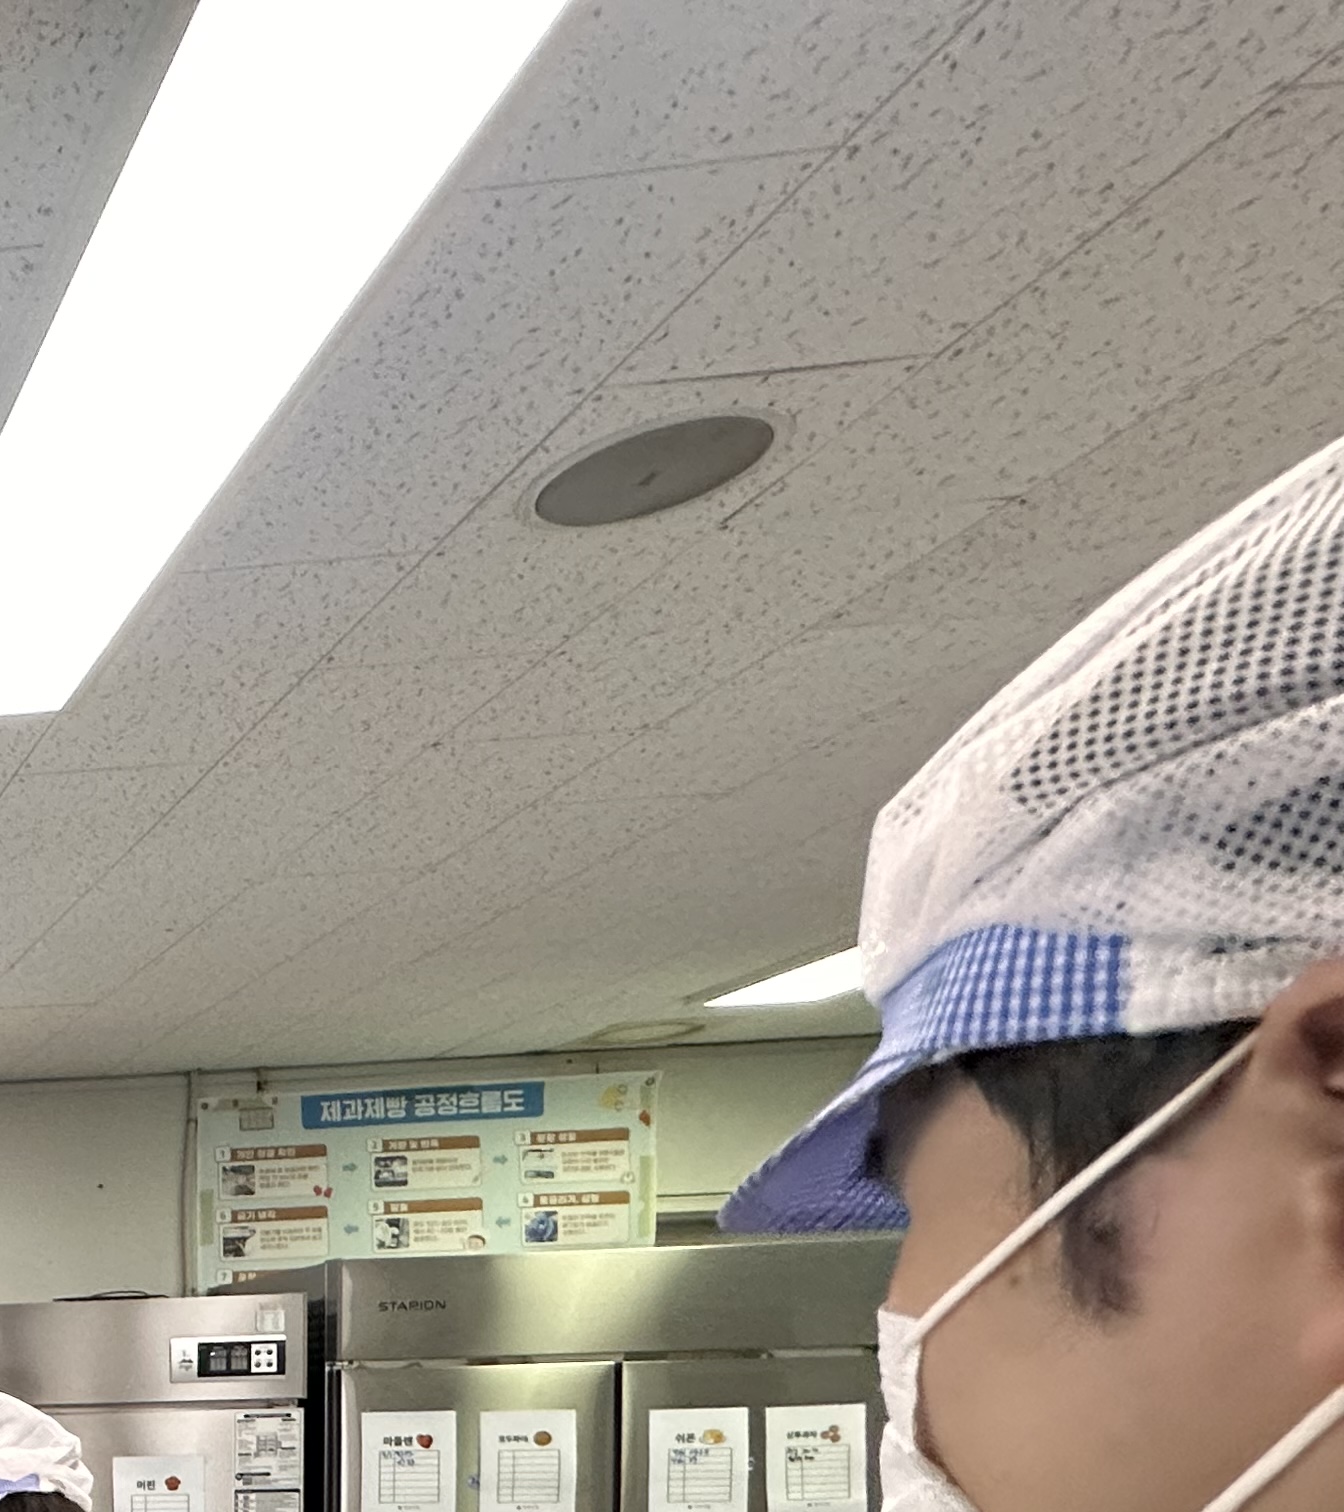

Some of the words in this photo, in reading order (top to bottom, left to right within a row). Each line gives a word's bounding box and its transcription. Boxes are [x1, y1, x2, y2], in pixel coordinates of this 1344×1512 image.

[321, 1096, 408, 1122] 제과제빵
[415, 1090, 525, 1117] 공정흐름도
[378, 1299, 447, 1312] STARION
